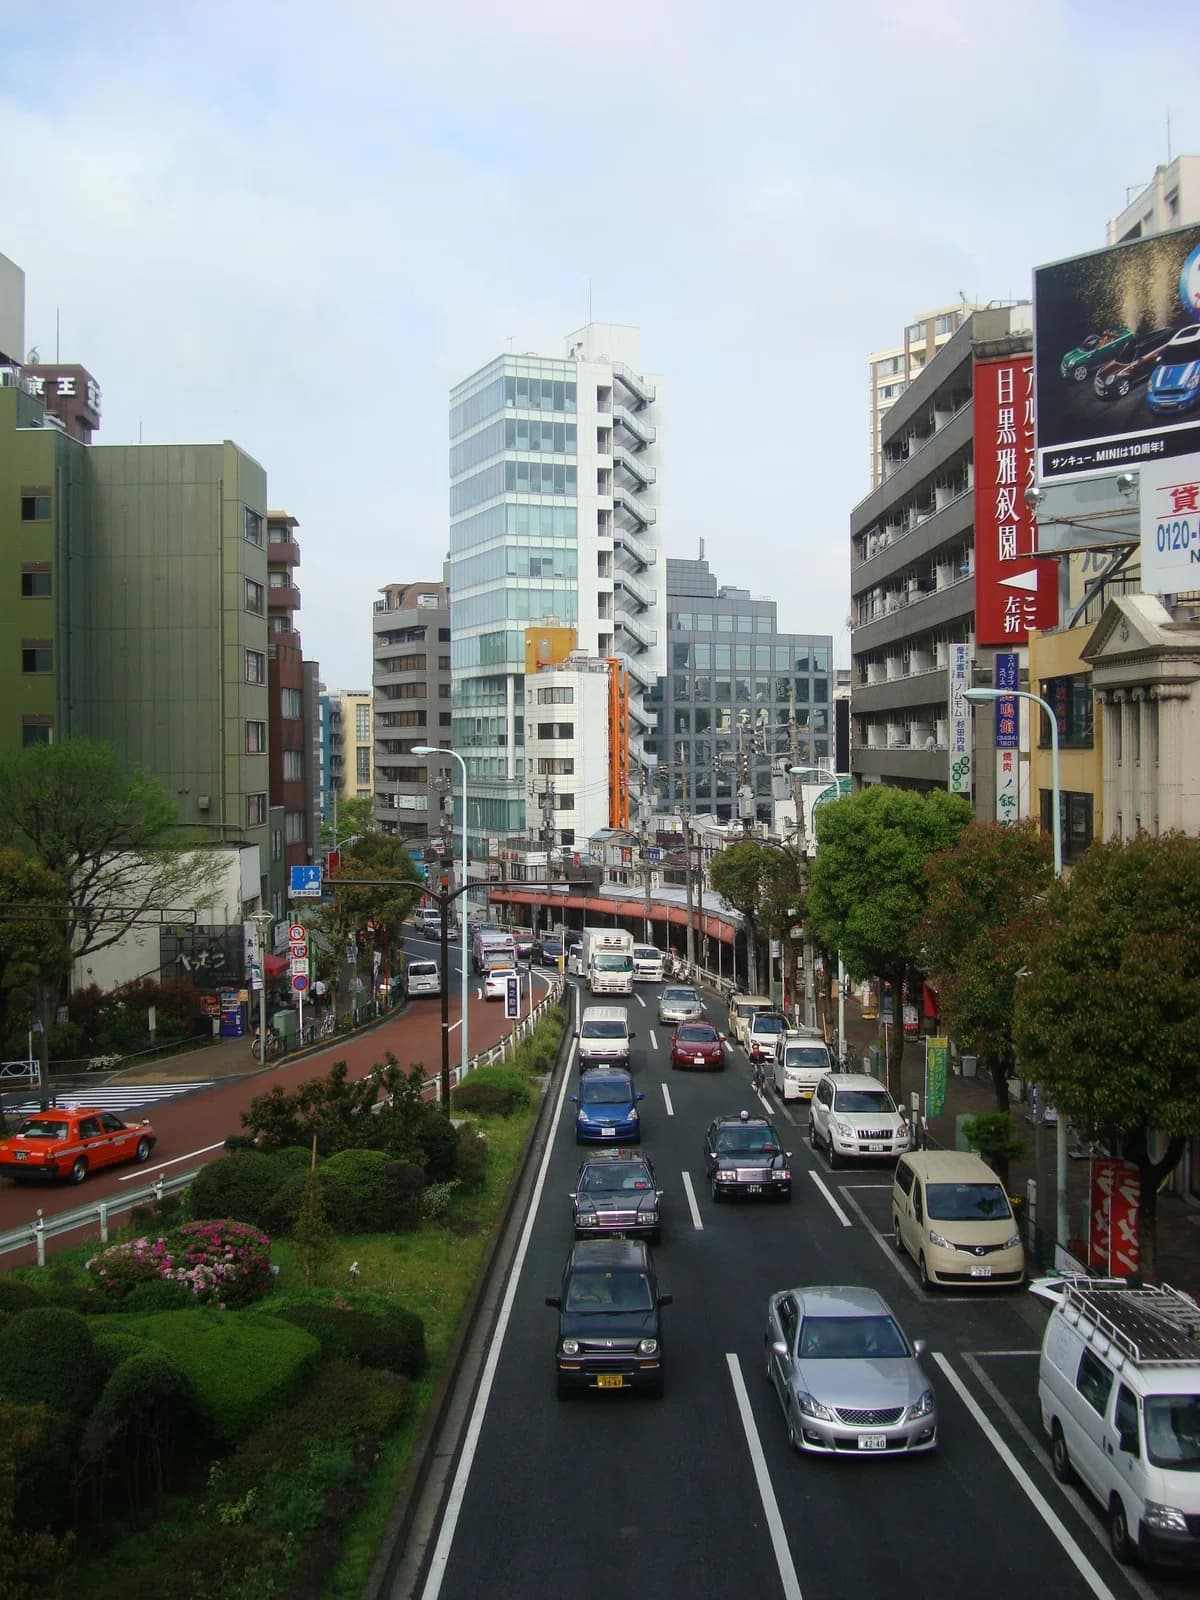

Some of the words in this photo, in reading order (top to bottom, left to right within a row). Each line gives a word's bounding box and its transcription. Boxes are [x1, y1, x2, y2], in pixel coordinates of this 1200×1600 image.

[995, 368, 1020, 561] 目黒雅叙園
[1156, 520, 1200, 553] 0120-
[1003, 596, 1021, 633] 左折
[1023, 596, 1037, 631] ここ
[1002, 751, 1012, 772] 焼肉
[864, 1440, 885, 1448] 42-40
